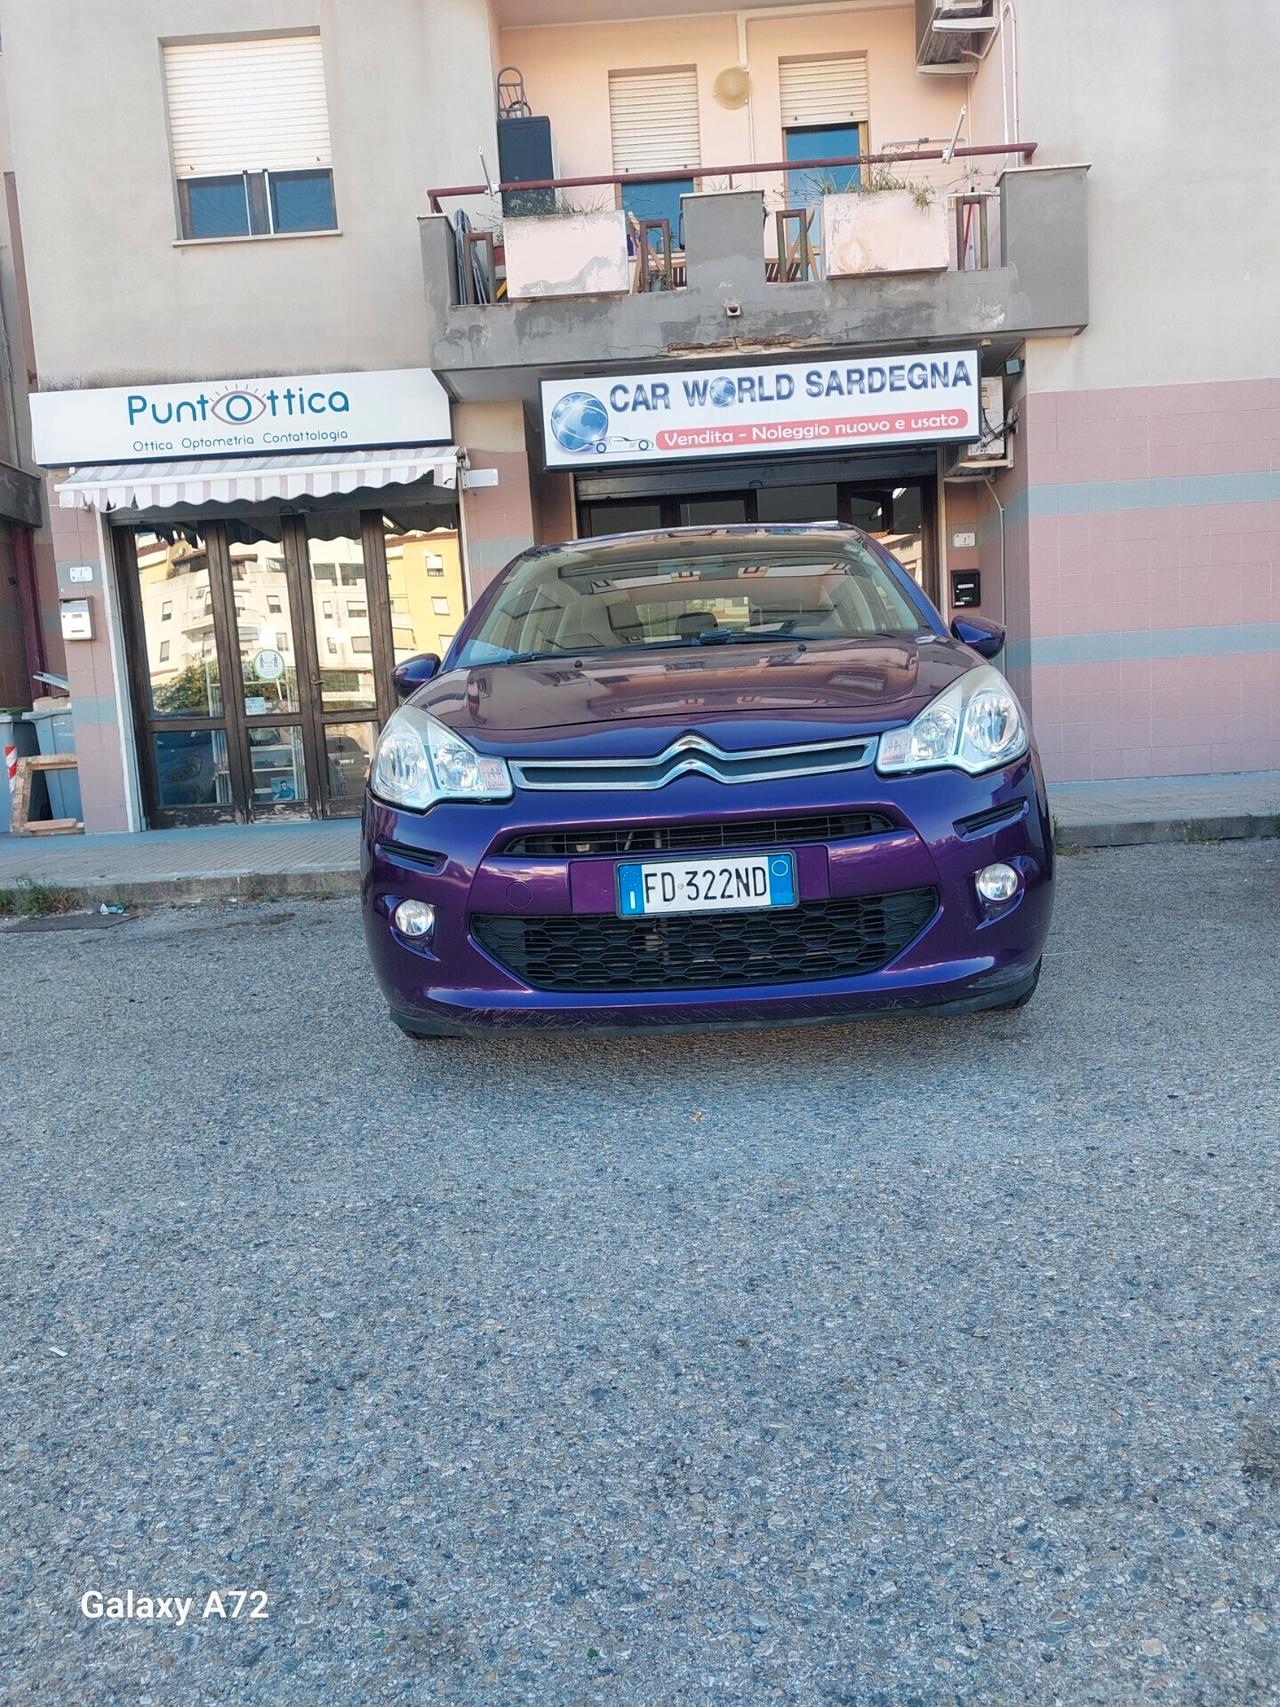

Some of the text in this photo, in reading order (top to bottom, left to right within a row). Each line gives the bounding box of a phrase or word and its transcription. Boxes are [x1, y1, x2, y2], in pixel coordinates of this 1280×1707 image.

[609, 382, 671, 412] CAR
[805, 360, 972, 398] SARDEGNA
[133, 429, 348, 452] Ottica Optometria Contattologia
[664, 430, 733, 446] Vendita
[752, 424, 830, 440] Noleggio
[835, 420, 890, 434] nuovo
[895, 419, 906, 430] e
[911, 414, 959, 428] usato
